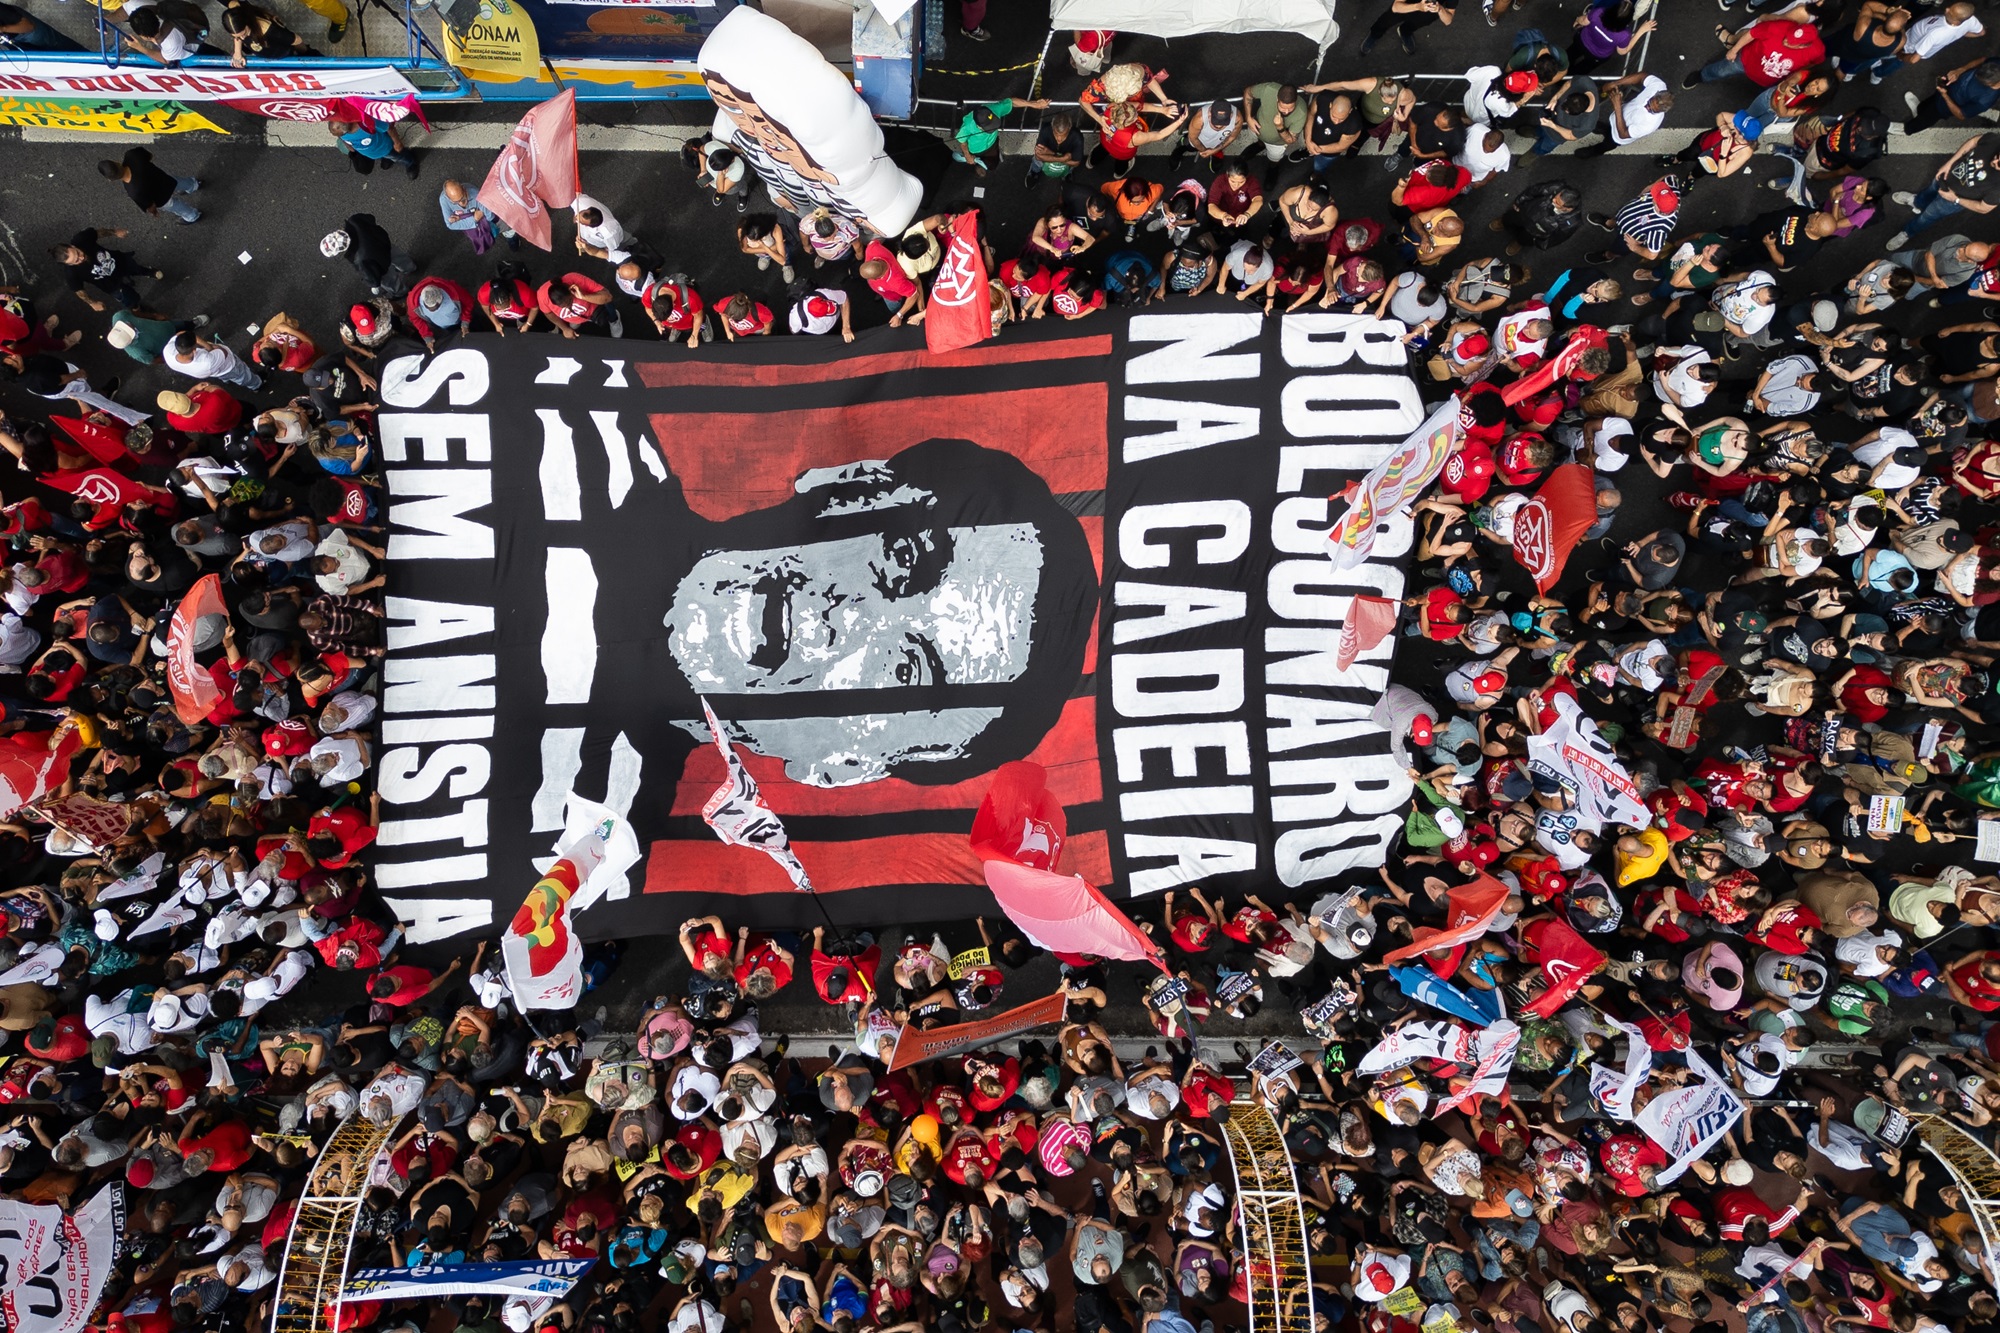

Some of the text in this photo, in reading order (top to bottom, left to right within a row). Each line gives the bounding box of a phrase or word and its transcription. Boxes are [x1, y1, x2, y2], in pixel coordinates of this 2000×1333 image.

[1111, 312, 1263, 898] NA CADEIA
[374, 348, 497, 945] SEM ANISTIA
[950, 957, 985, 971] INIMIGO
[1224, 978, 1254, 1002] BRASIL
[1315, 990, 1347, 1022] BASTA
[112, 1183, 124, 1208] UGT
[114, 1209, 124, 1232] UGT
